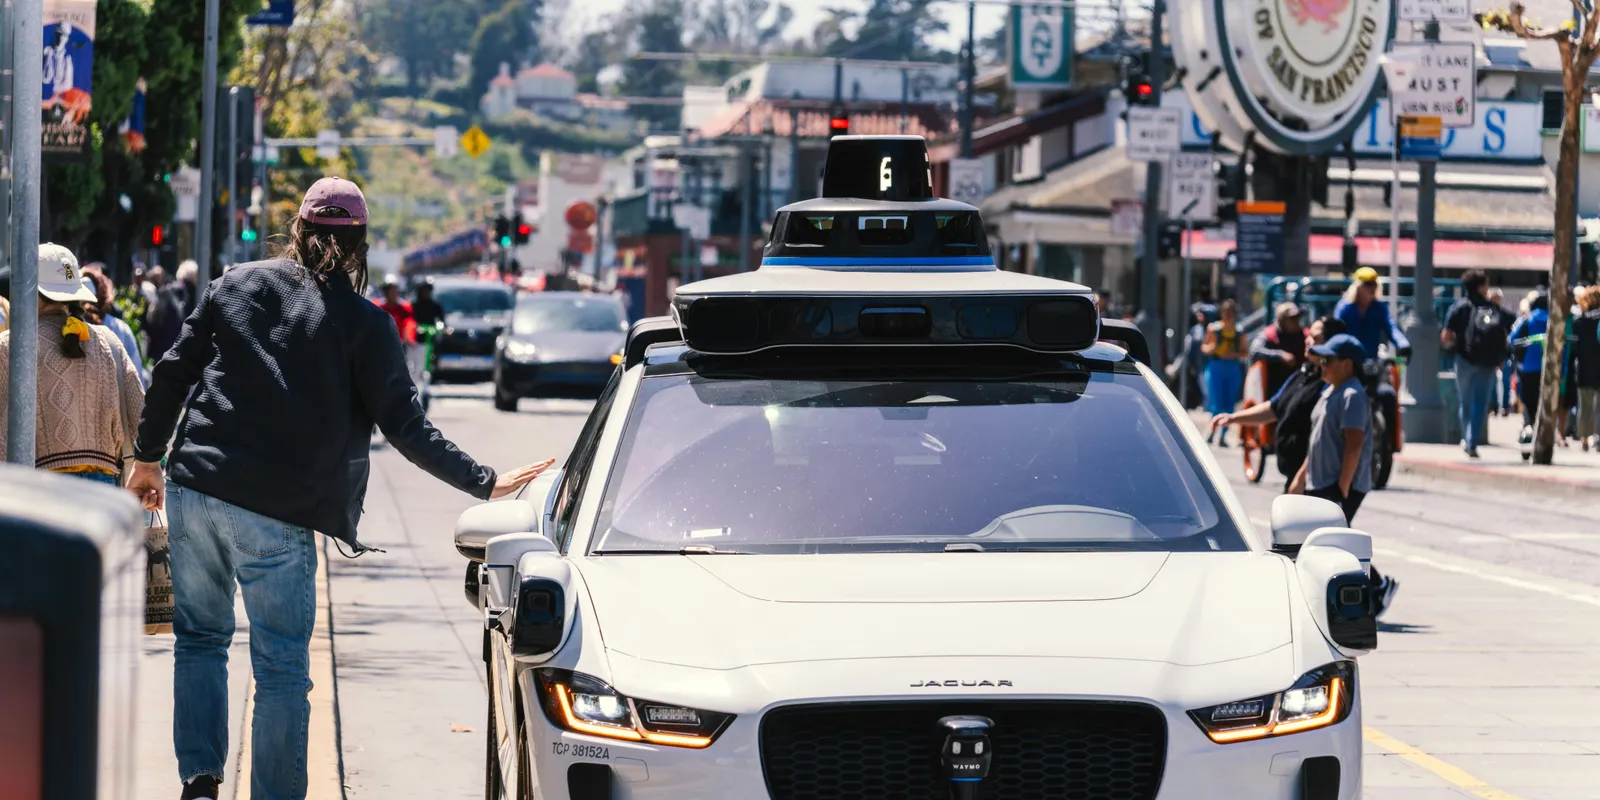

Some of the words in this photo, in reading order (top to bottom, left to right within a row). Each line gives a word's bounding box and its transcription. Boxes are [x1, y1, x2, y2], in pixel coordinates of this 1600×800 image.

[1266, 45, 1298, 93] SAN
[1300, 16, 1377, 103] FRANCISCO
[1437, 56, 1468, 67] LANE
[1402, 101, 1428, 113] URN
[1433, 101, 1468, 113] RIGT
[552, 742, 570, 755] TCP
[571, 744, 610, 760] 38152A
